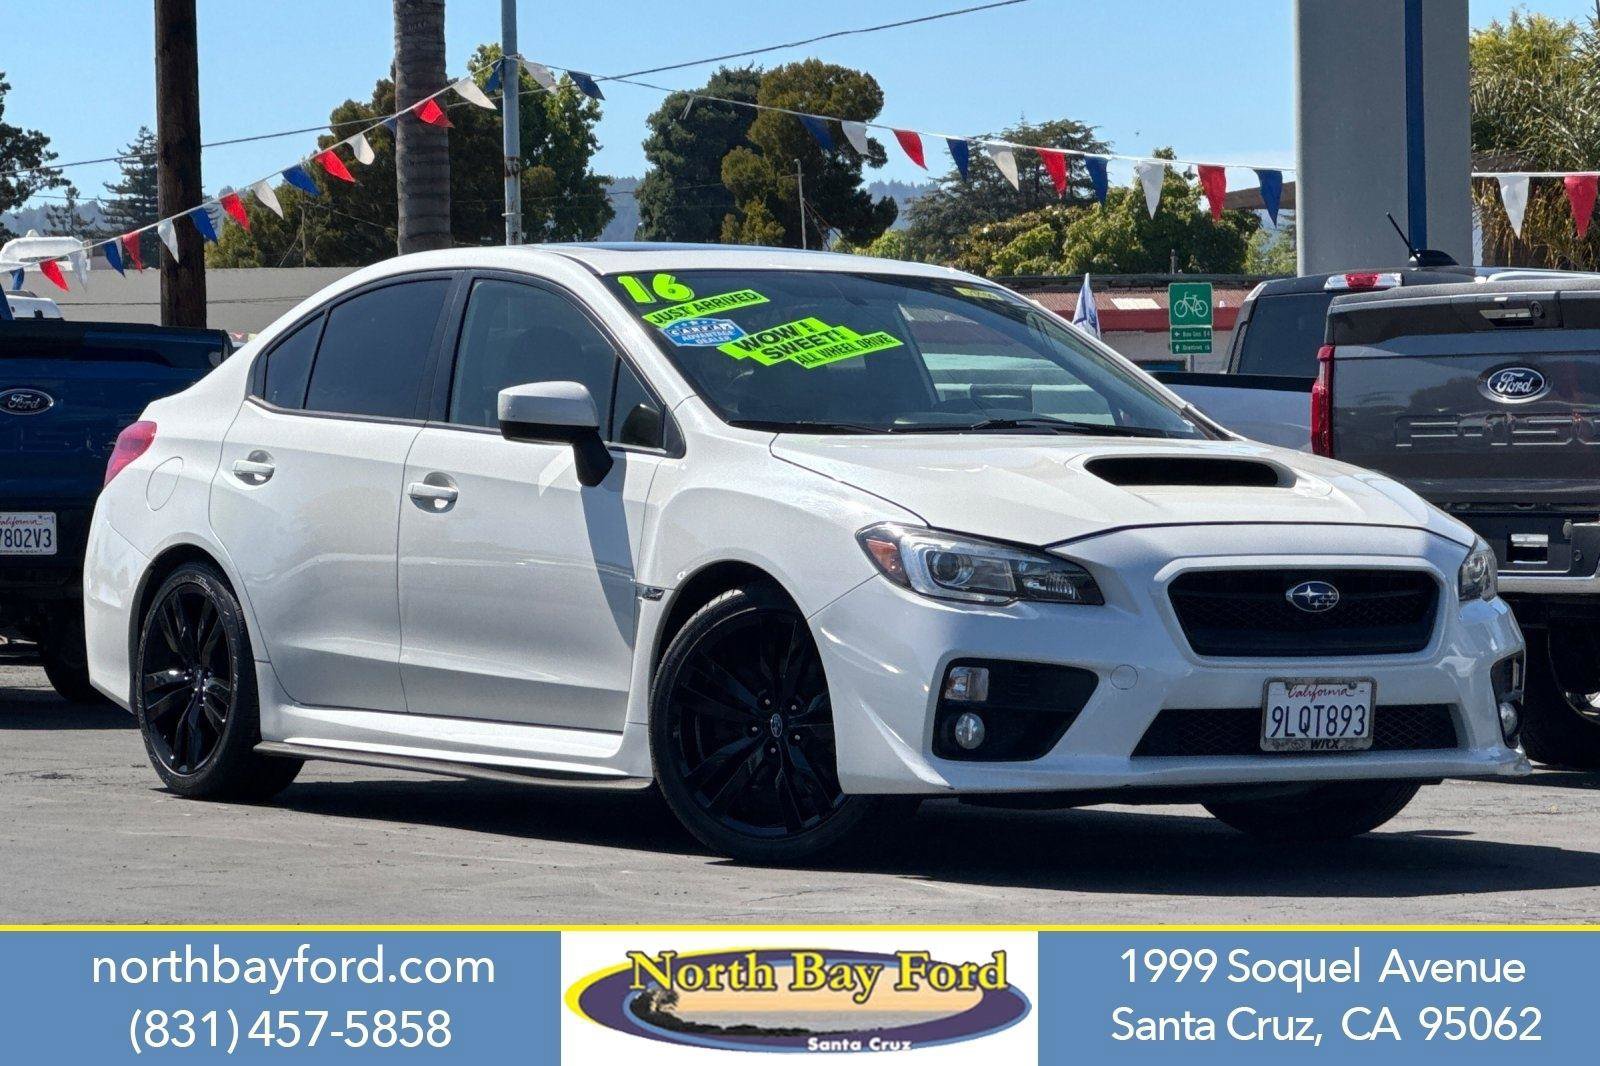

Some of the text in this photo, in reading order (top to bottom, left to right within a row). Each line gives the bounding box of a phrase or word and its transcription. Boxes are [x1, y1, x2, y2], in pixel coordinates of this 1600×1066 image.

[617, 273, 695, 303] 16
[653, 292, 759, 324] JUST ARRIVED
[761, 329, 849, 359] SWEET!
[794, 333, 894, 364] ALL WHEEL DRIVE
[1495, 370, 1534, 394] Ford
[8, 393, 41, 409] Ford
[0, 516, 42, 528] alifornia
[1288, 685, 1354, 703] California
[1271, 704, 1366, 737] 9LQT893
[1311, 738, 1340, 750] WRX
